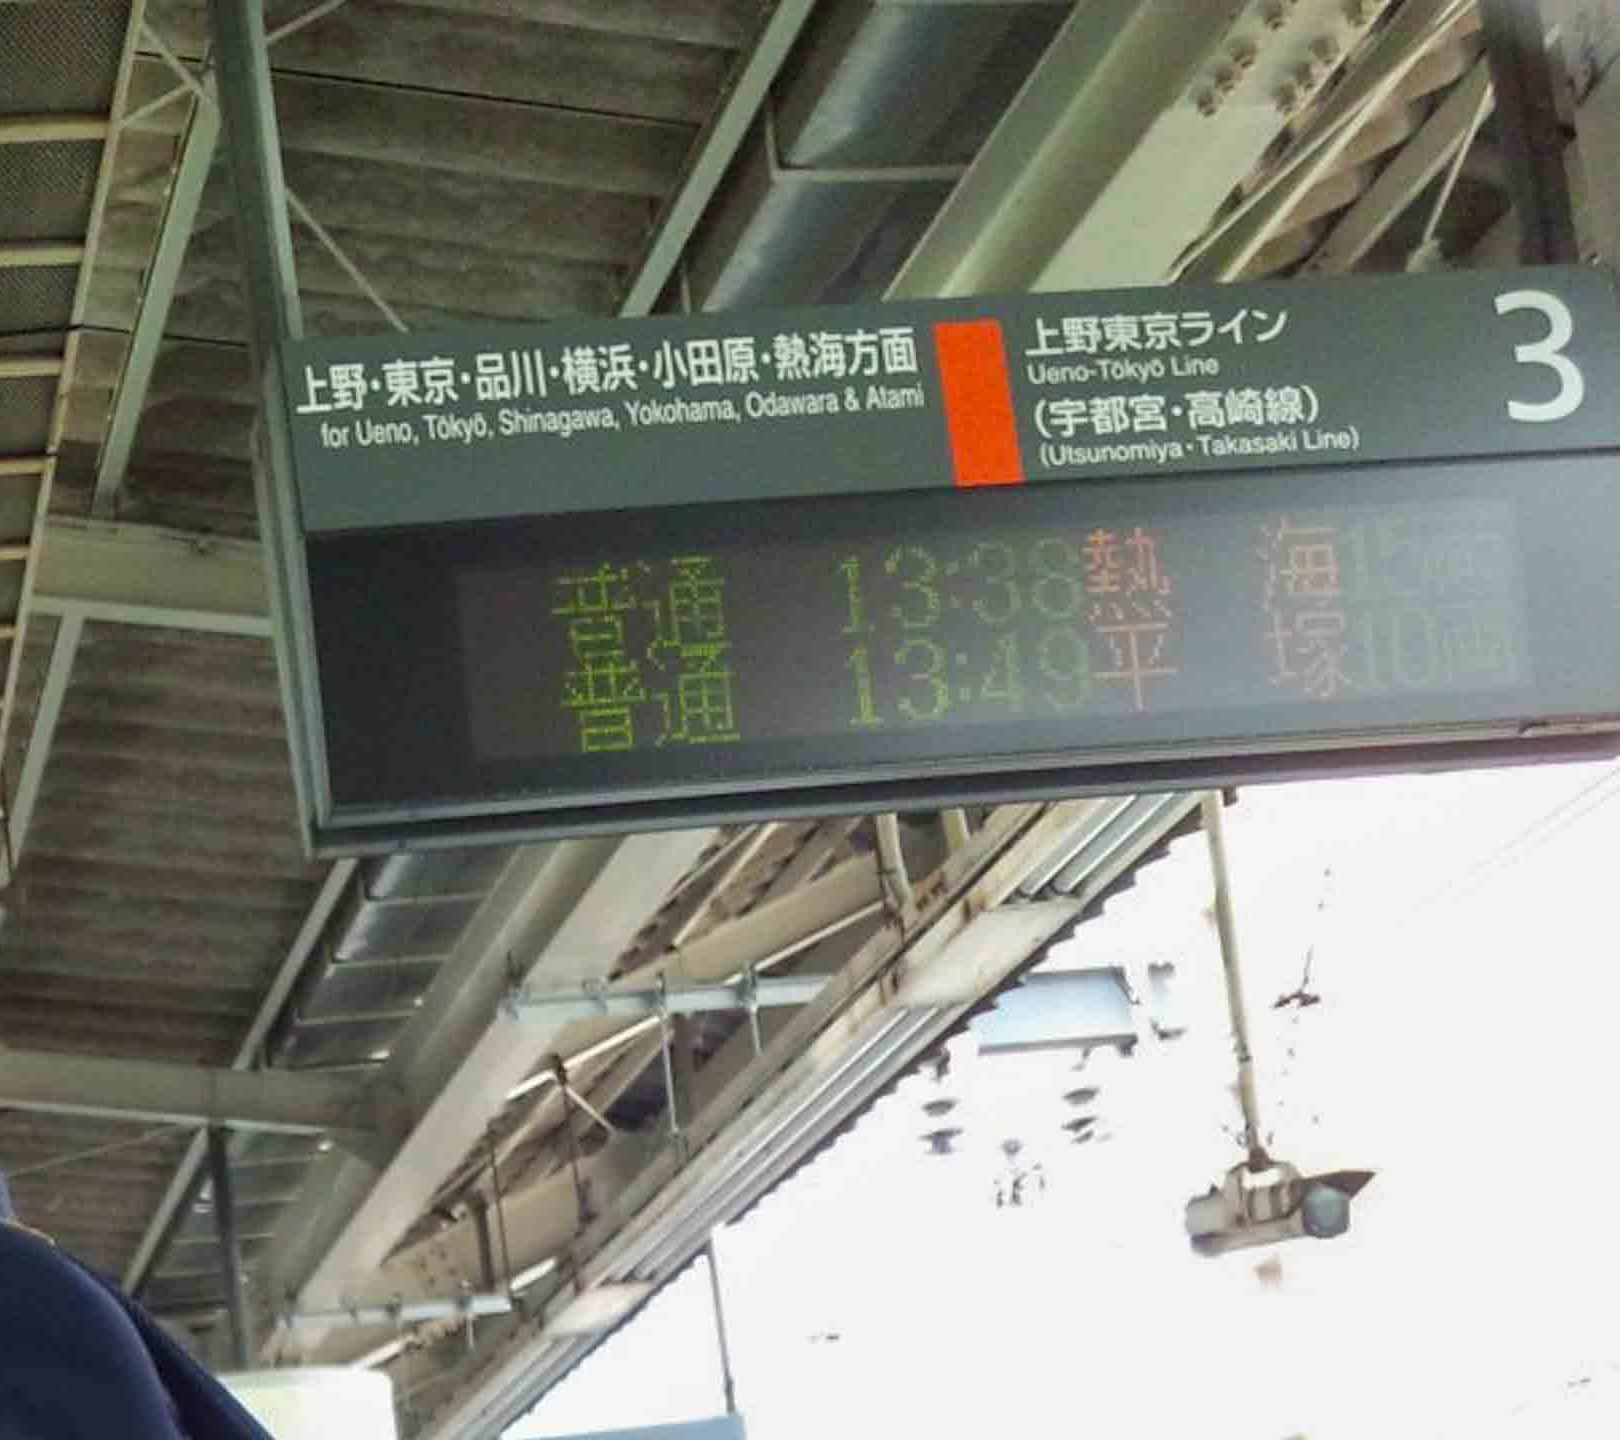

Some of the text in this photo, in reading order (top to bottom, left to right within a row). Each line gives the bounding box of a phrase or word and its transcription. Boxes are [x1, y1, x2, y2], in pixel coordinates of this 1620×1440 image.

[1025, 308, 1289, 357] 上野東京ライン
[1170, 354, 1220, 378] Line
[1492, 289, 1586, 423] 3
[320, 421, 350, 448] for
[355, 417, 420, 446] Ueno,
[499, 405, 621, 438] Shinagawa,
[624, 396, 742, 427] Yokohama,
[745, 387, 840, 418] Odawara
[844, 385, 860, 412] &
[866, 381, 926, 410] Atami
[1302, 425, 1361, 452] Line)
[552, 555, 727, 656] 普通
[560, 648, 741, 753] 普通
[843, 627, 1089, 728] 13:49
